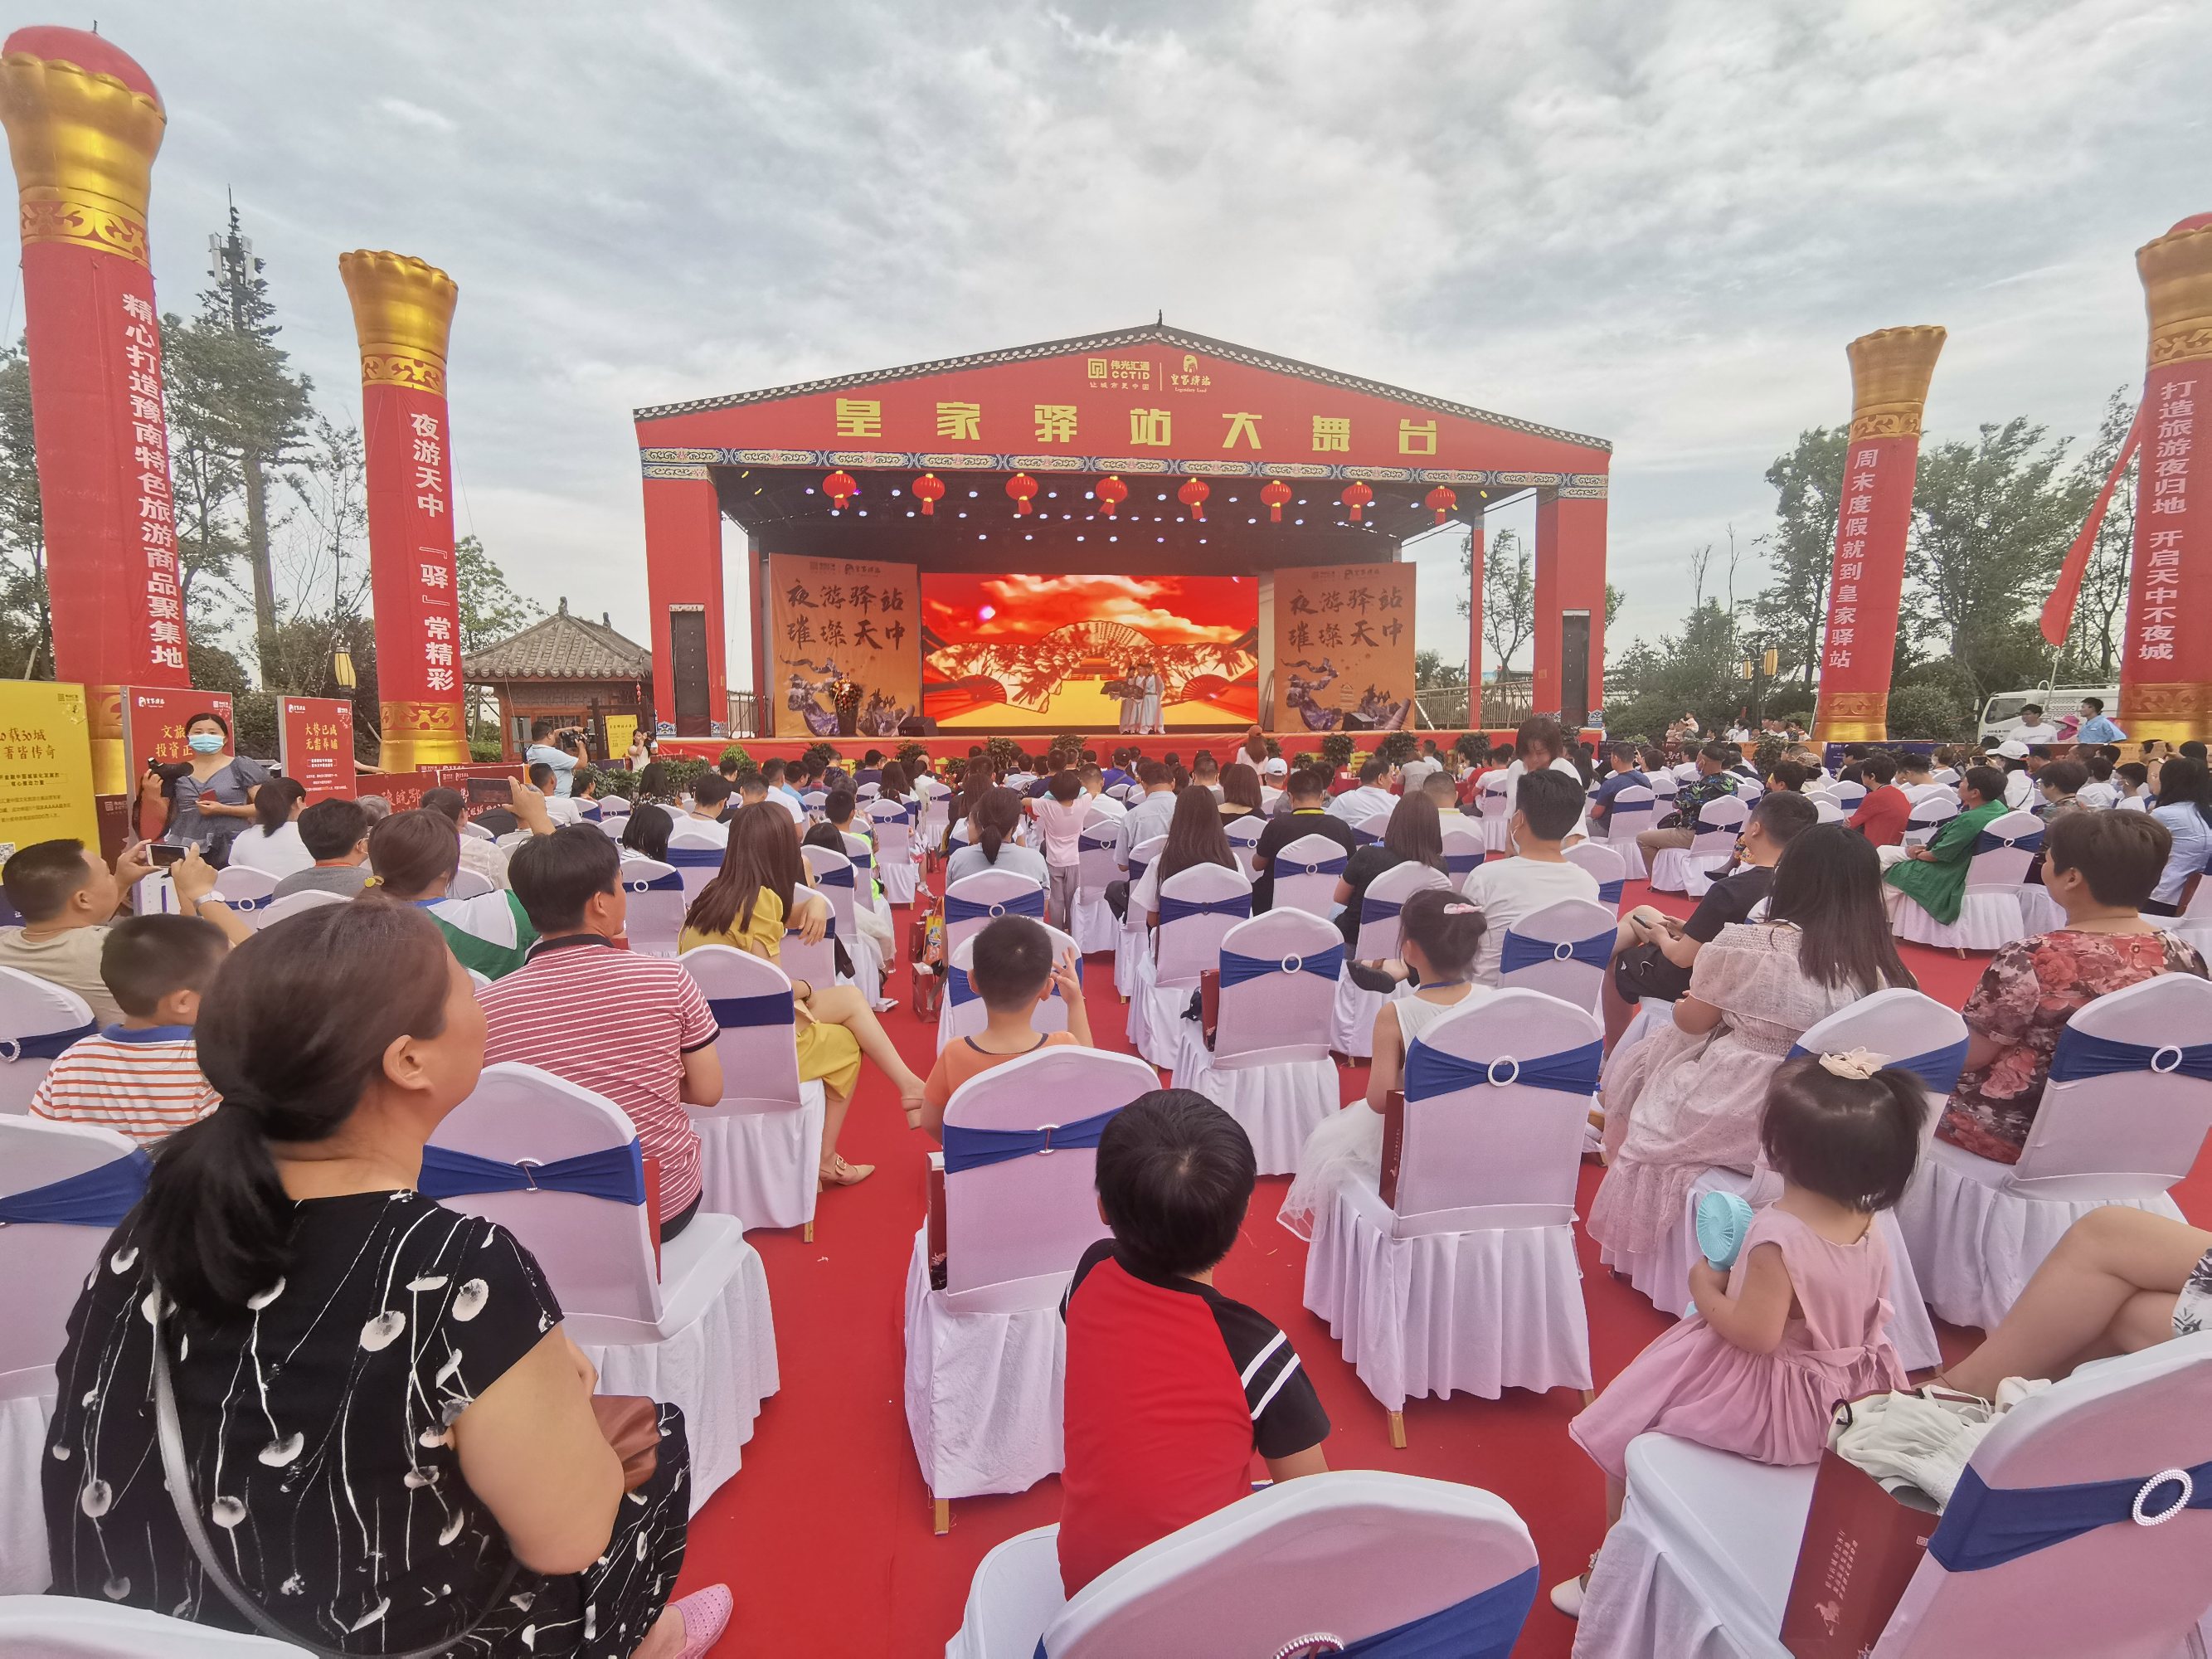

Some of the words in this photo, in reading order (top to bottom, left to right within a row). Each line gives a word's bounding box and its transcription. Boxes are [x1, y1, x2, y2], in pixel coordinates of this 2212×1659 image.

[1111, 360, 1150, 372] 伟光汇通
[1111, 370, 1150, 380] CCTID
[835, 398, 1437, 455] 皇家驿站大舞台
[2151, 380, 2197, 514] 打造旅游夜归地
[123, 294, 183, 669] 精心打造豫南特色旅游商品聚集地
[411, 413, 444, 518] 夜游天中
[1829, 448, 1879, 669] 周末度假就到皇家驿站
[788, 578, 903, 615] 夜游驿站
[1291, 586, 1403, 616] 夜游驿站
[2138, 529, 2184, 660] 开启天中不夜城
[787, 614, 906, 651] 璀璨天中
[1288, 618, 1403, 653] 璀璨天中
